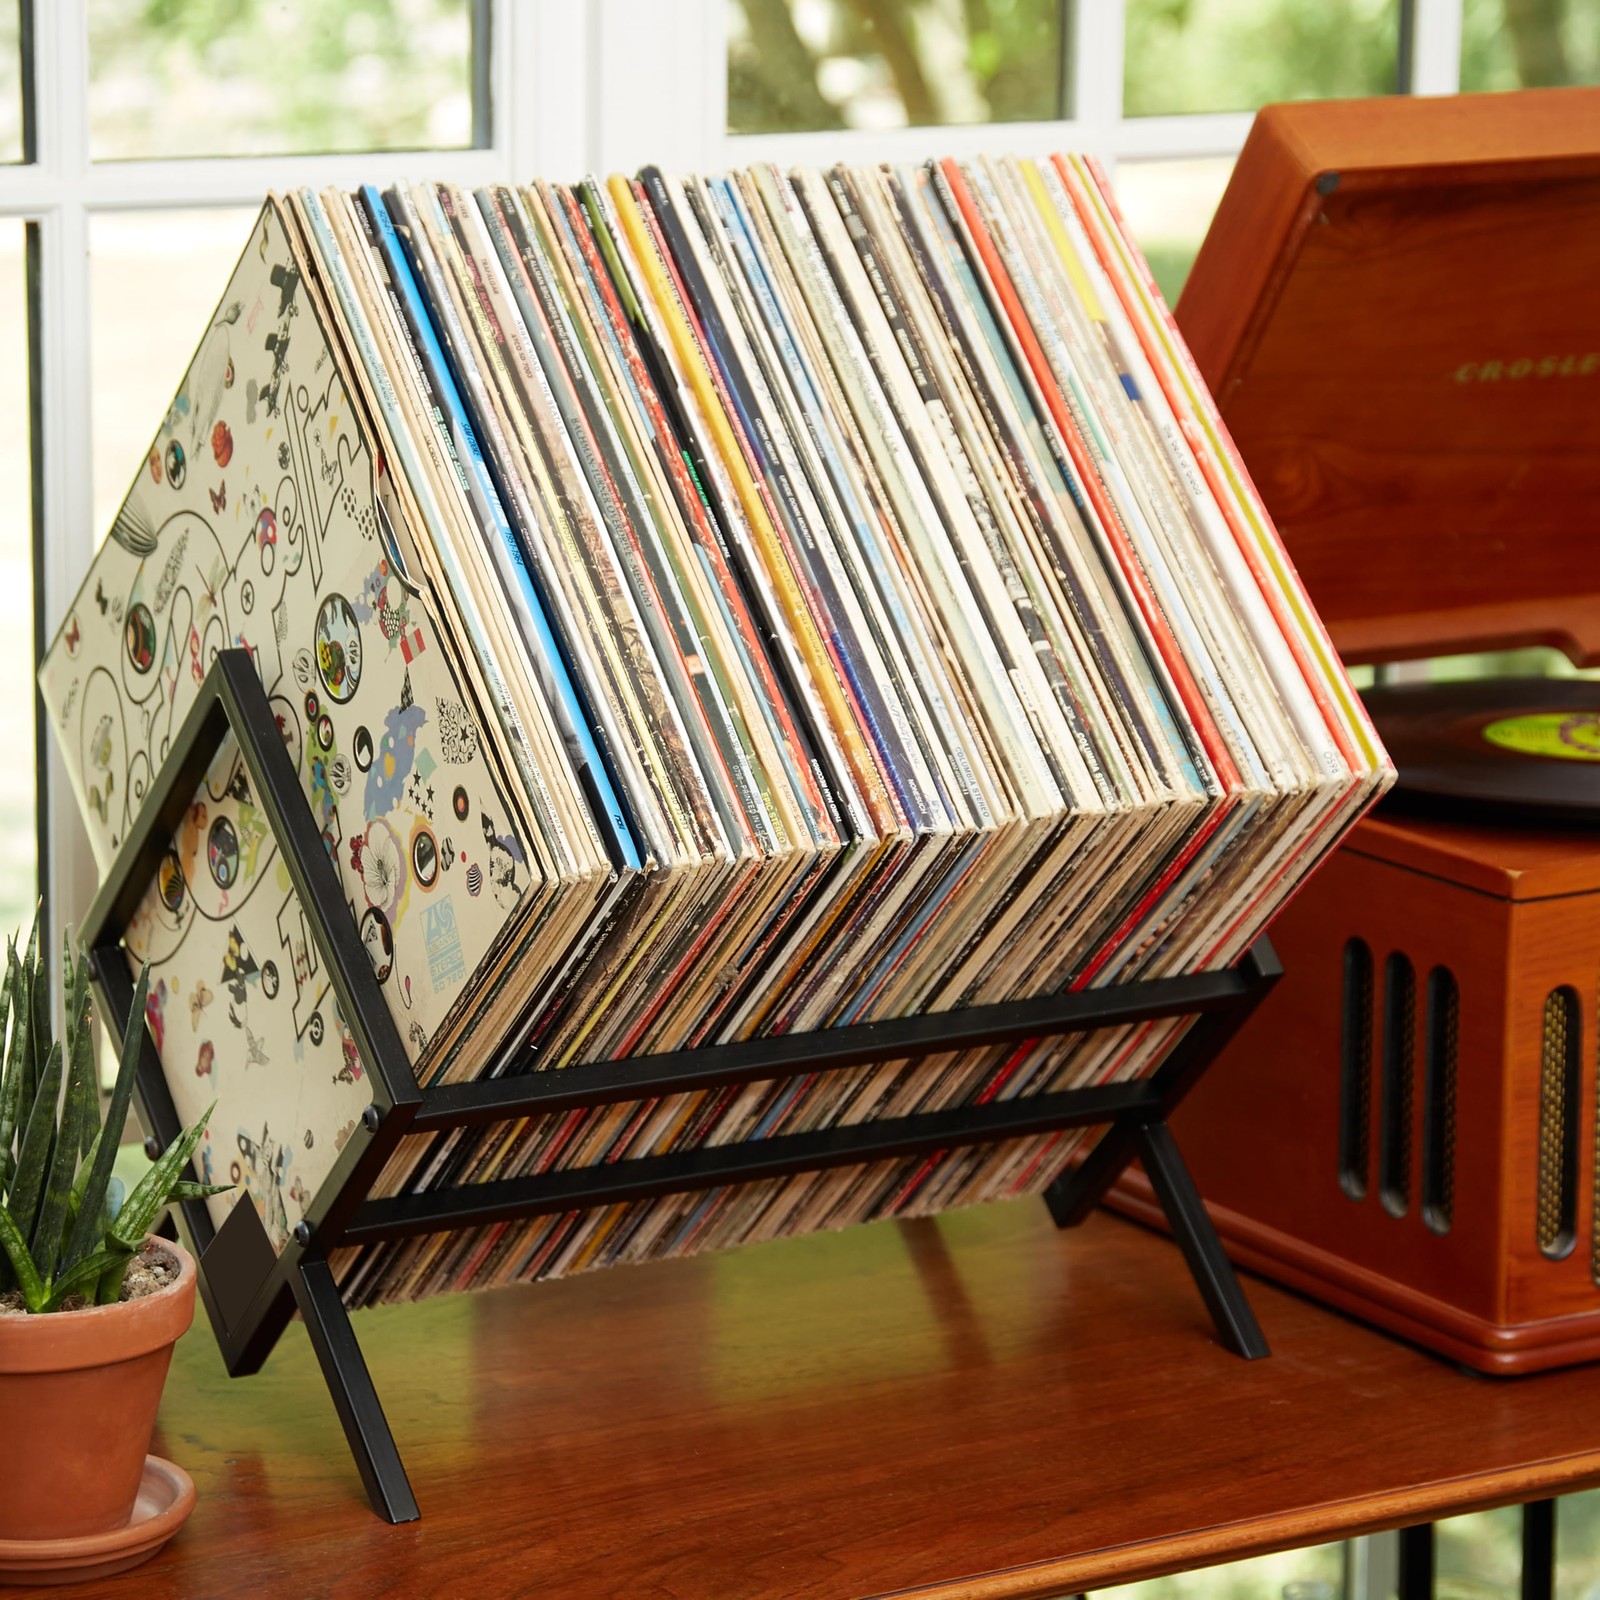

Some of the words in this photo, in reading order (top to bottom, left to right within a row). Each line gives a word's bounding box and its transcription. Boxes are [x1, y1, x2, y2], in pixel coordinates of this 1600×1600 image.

[522, 247, 534, 259] THE
[527, 259, 544, 284] ALLMAN
[479, 258, 500, 294] TRAFALGAR
[509, 333, 523, 351] ATCO
[538, 285, 558, 318] BROTHERS
[395, 310, 412, 339] COSTELLO
[412, 354, 424, 371] COOL
[418, 371, 433, 394] MINORS
[431, 406, 444, 421] THE
[525, 348, 541, 372] ROAD
[538, 381, 551, 397] THE
[460, 422, 472, 436] SAM
[466, 437, 481, 457] COOKE
[753, 417, 769, 439] CONOR
[763, 440, 779, 464] OBERST
[777, 475, 793, 496] UPSIDE
[787, 497, 801, 516] DOWN
[795, 517, 815, 549] MOUNTAIN
[569, 417, 612, 503] BACHMAN-TURNER
[604, 505, 633, 557] OVERDRIVE
[628, 564, 654, 608] MERCURY
[704, 506, 726, 545] RACONTEURS
[720, 545, 731, 558] THE
[810, 758, 828, 787] RECORDS
[953, 746, 977, 786] COLUMBIA
[971, 787, 990, 817] STEREO
[1075, 732, 1100, 771] COLUMBIA
[1094, 772, 1113, 801] STEREO
[822, 788, 834, 802] MAN
[828, 803, 842, 823] THIRD
[906, 778, 928, 814] NONESUCH
[759, 791, 774, 811] EPIC
[767, 812, 787, 843] STEREO
[430, 949, 464, 977] STEREO
